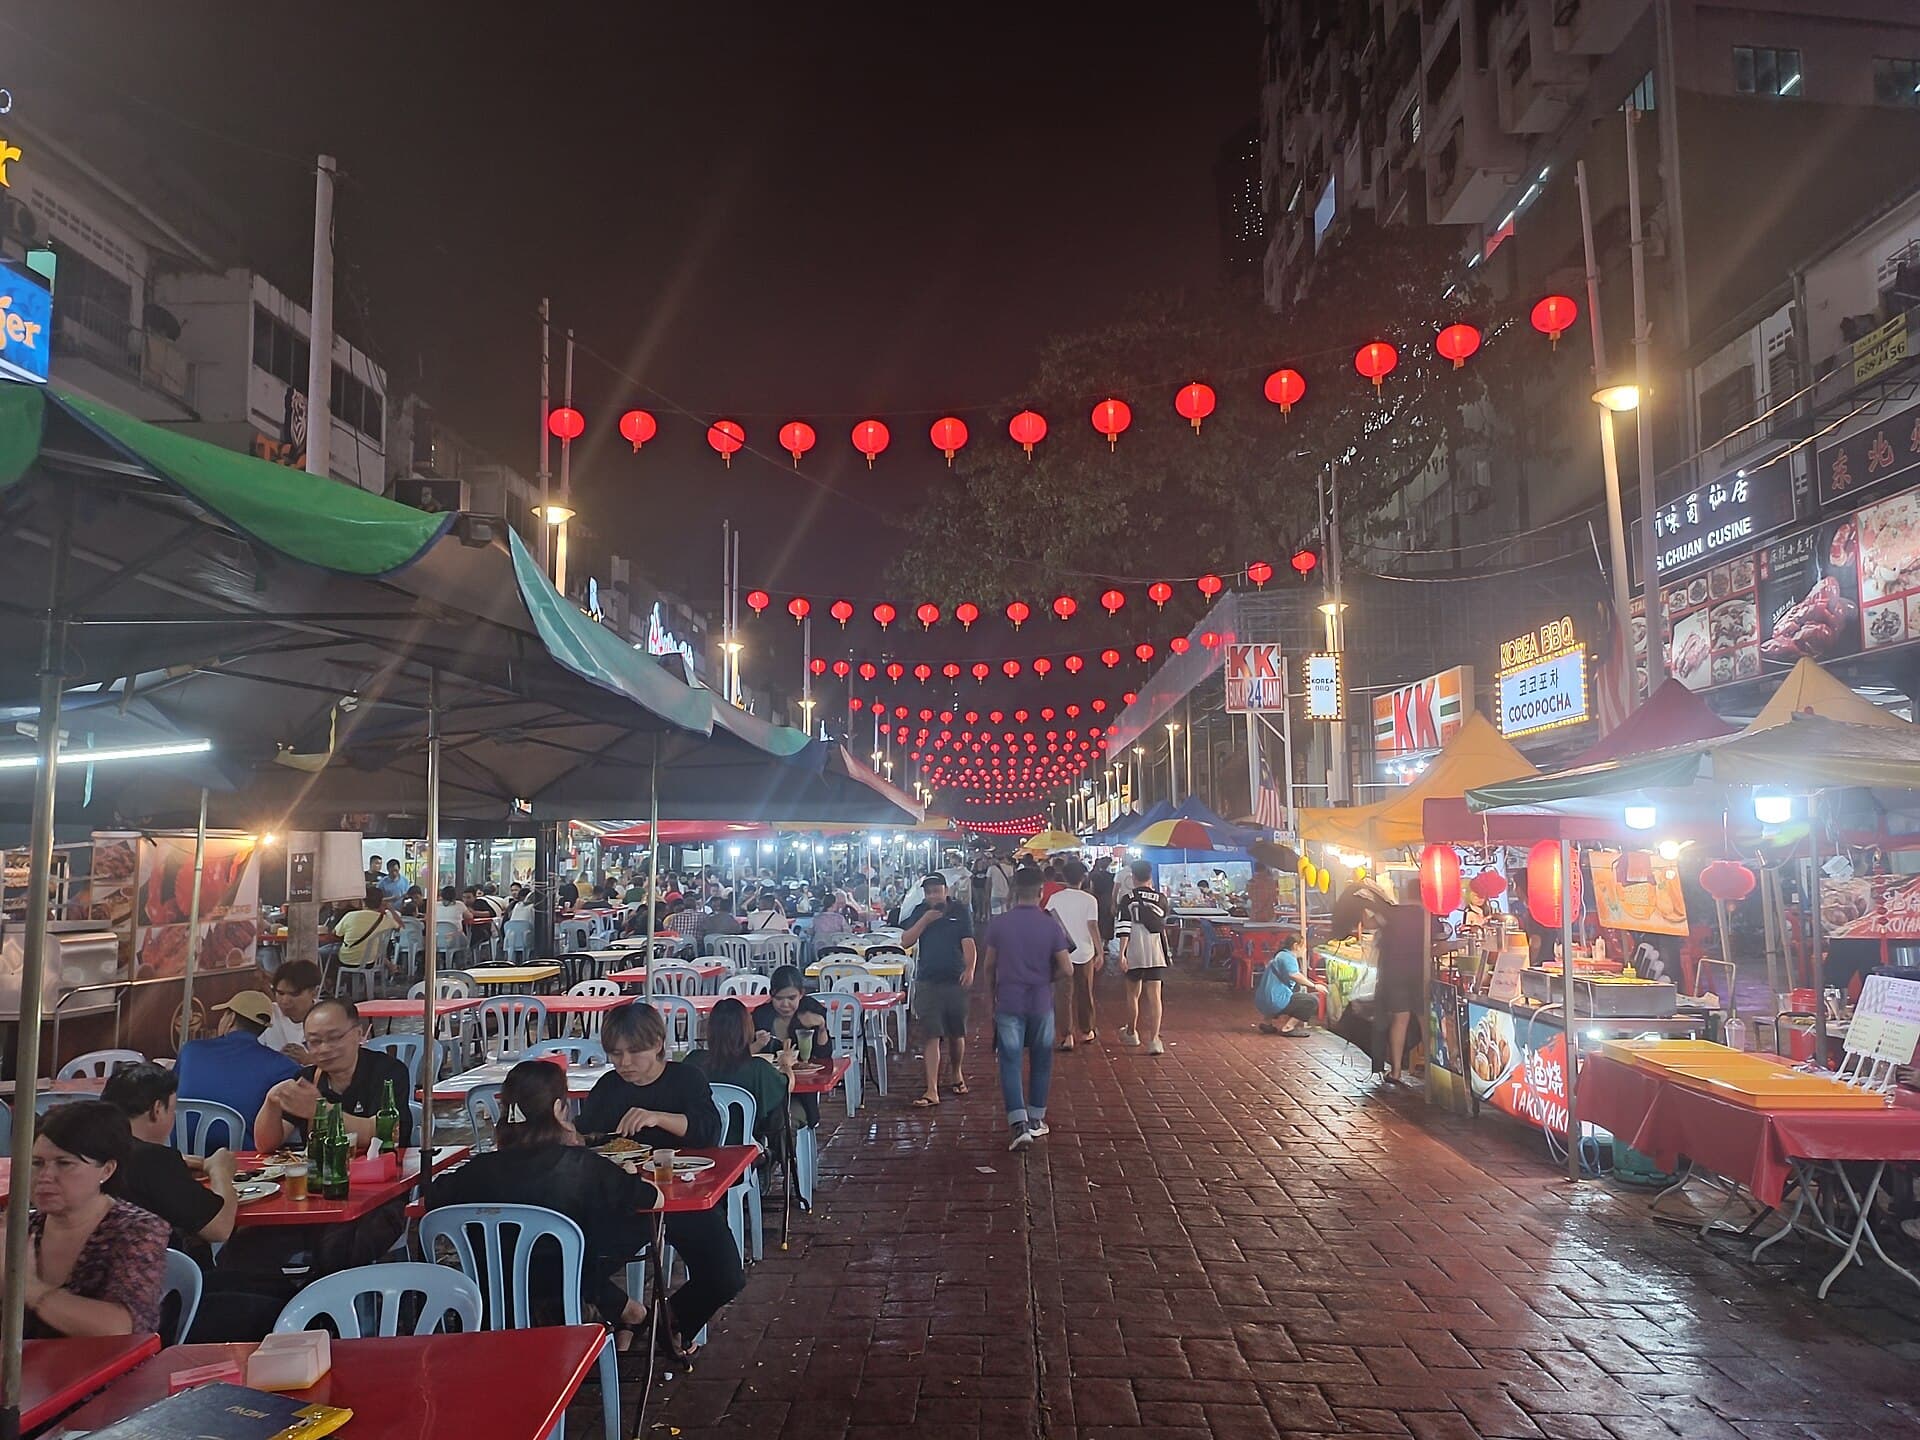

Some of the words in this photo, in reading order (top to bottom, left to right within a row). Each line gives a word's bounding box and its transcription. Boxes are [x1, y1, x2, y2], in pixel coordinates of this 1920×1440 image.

[1707, 516, 1752, 548] CUSINE
[1501, 631, 1539, 668] KOREA
[1541, 616, 1574, 653] BBQ
[1230, 646, 1276, 677] KK
[1247, 680, 1262, 708] 24
[1263, 680, 1279, 707] JAM
[1519, 667, 1558, 697] 코코포차
[1394, 679, 1439, 756] KK
[1508, 692, 1572, 723] COCOPOCHA
